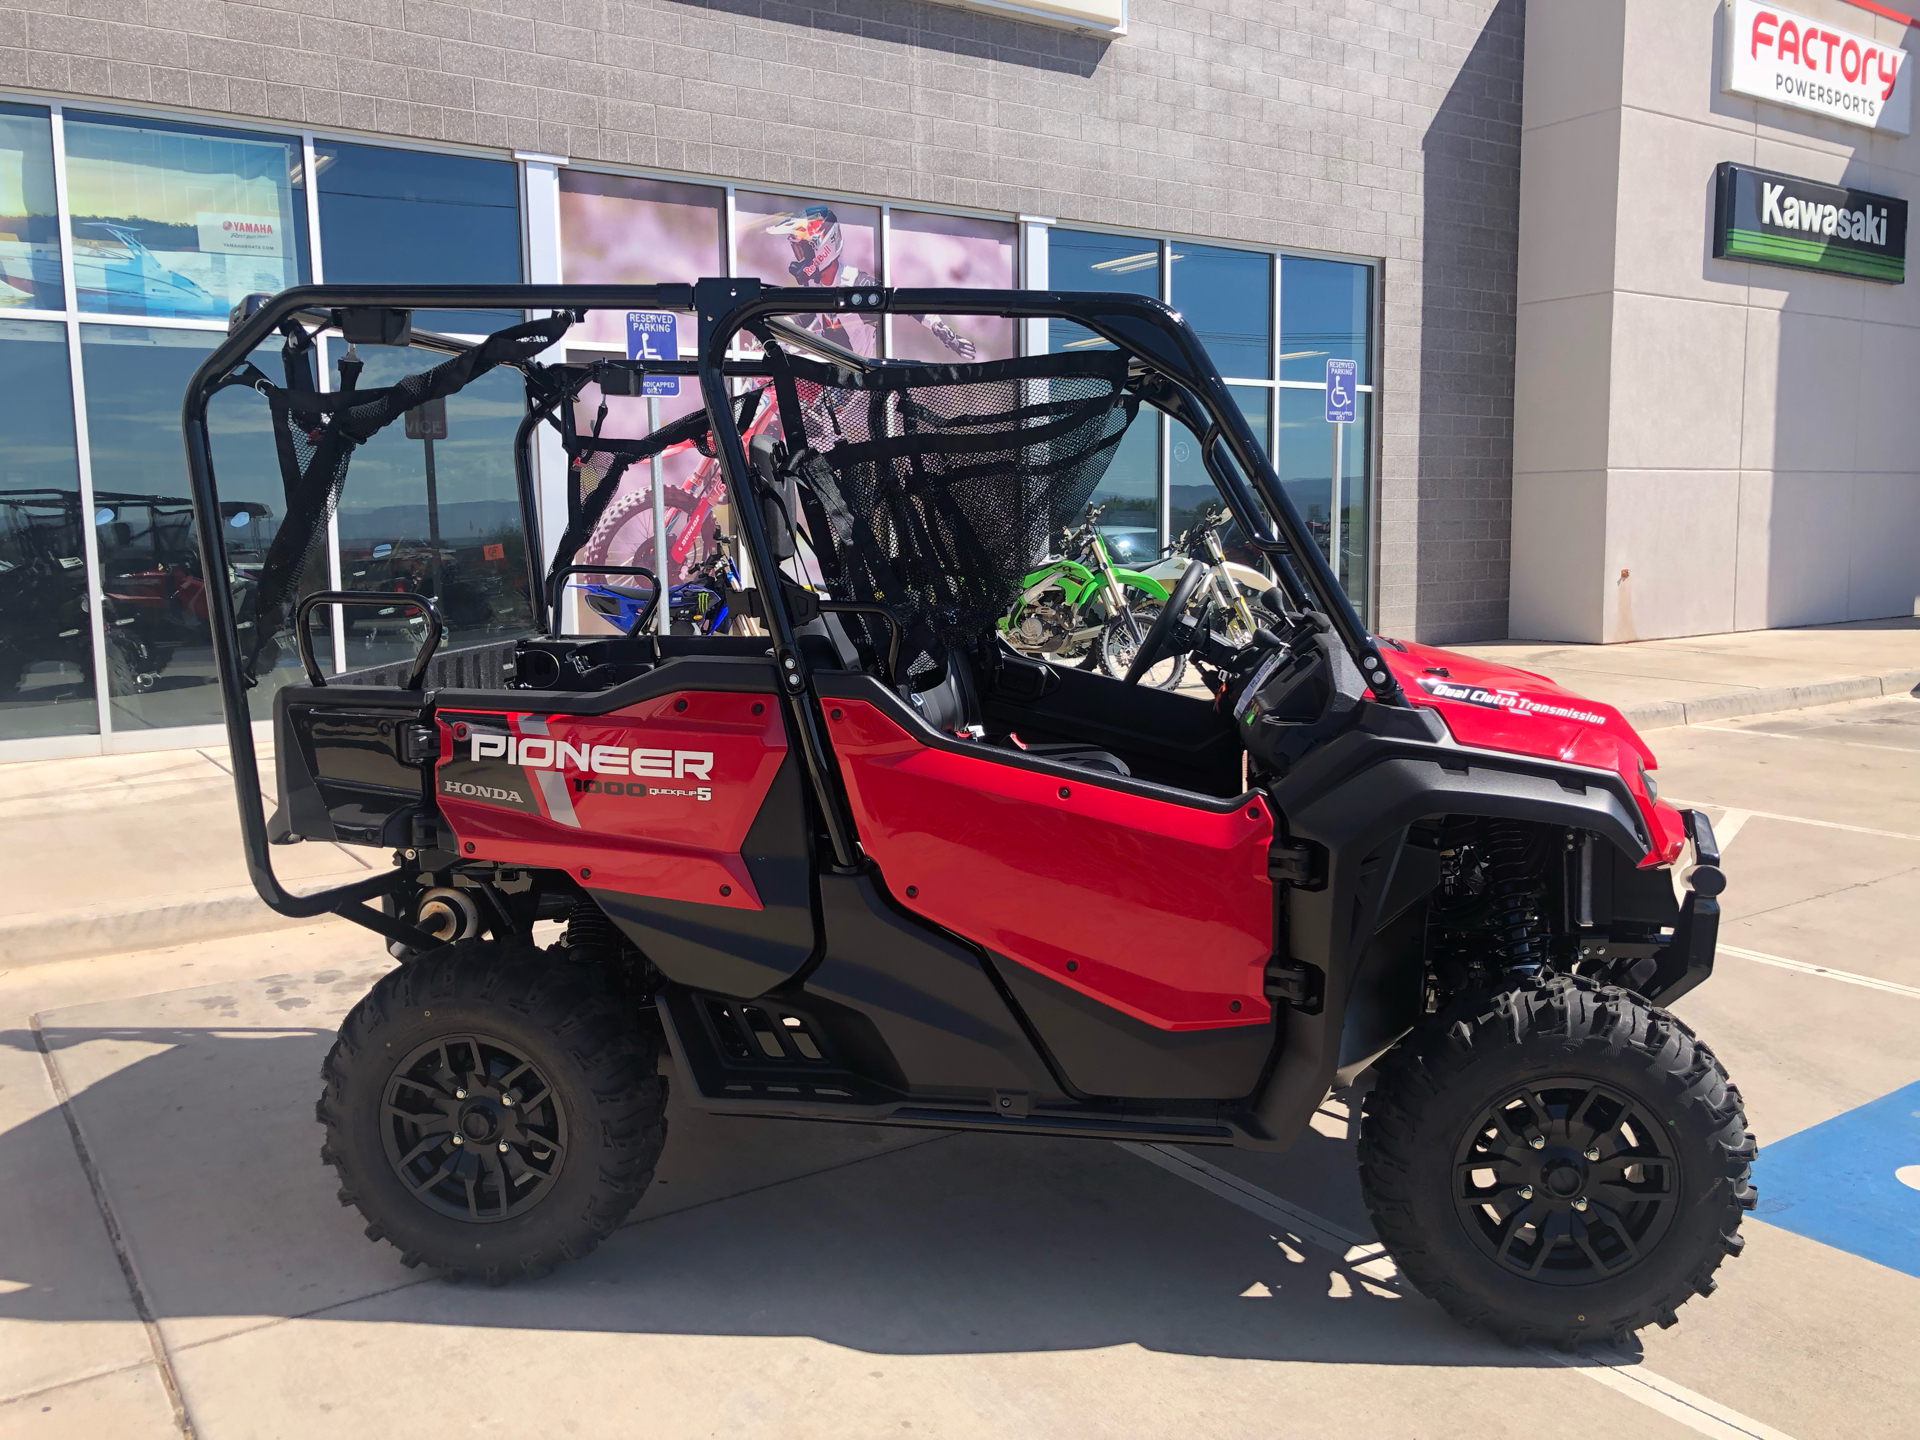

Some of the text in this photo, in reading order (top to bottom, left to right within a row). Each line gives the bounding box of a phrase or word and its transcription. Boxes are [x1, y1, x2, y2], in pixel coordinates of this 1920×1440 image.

[1776, 73, 1875, 117] POWERSPORTS
[1762, 181, 1888, 246] Kawasaki
[233, 221, 273, 234] YAMAHA
[223, 242, 274, 250] YAMAHABOATS.COM
[803, 245, 832, 276] Red Bull
[629, 313, 673, 324] RESERVED
[633, 322, 671, 333] PARKING
[1329, 361, 1354, 369] RESERVED
[1330, 368, 1353, 376] PARKING
[643, 381, 675, 389] NDICAPPED
[681, 514, 700, 546] DUNLOP
[1432, 684, 1606, 725] Dual Clutch Transmission
[471, 733, 714, 781] PIONEER
[444, 780, 524, 803] HONDA
[572, 778, 647, 797] 1000
